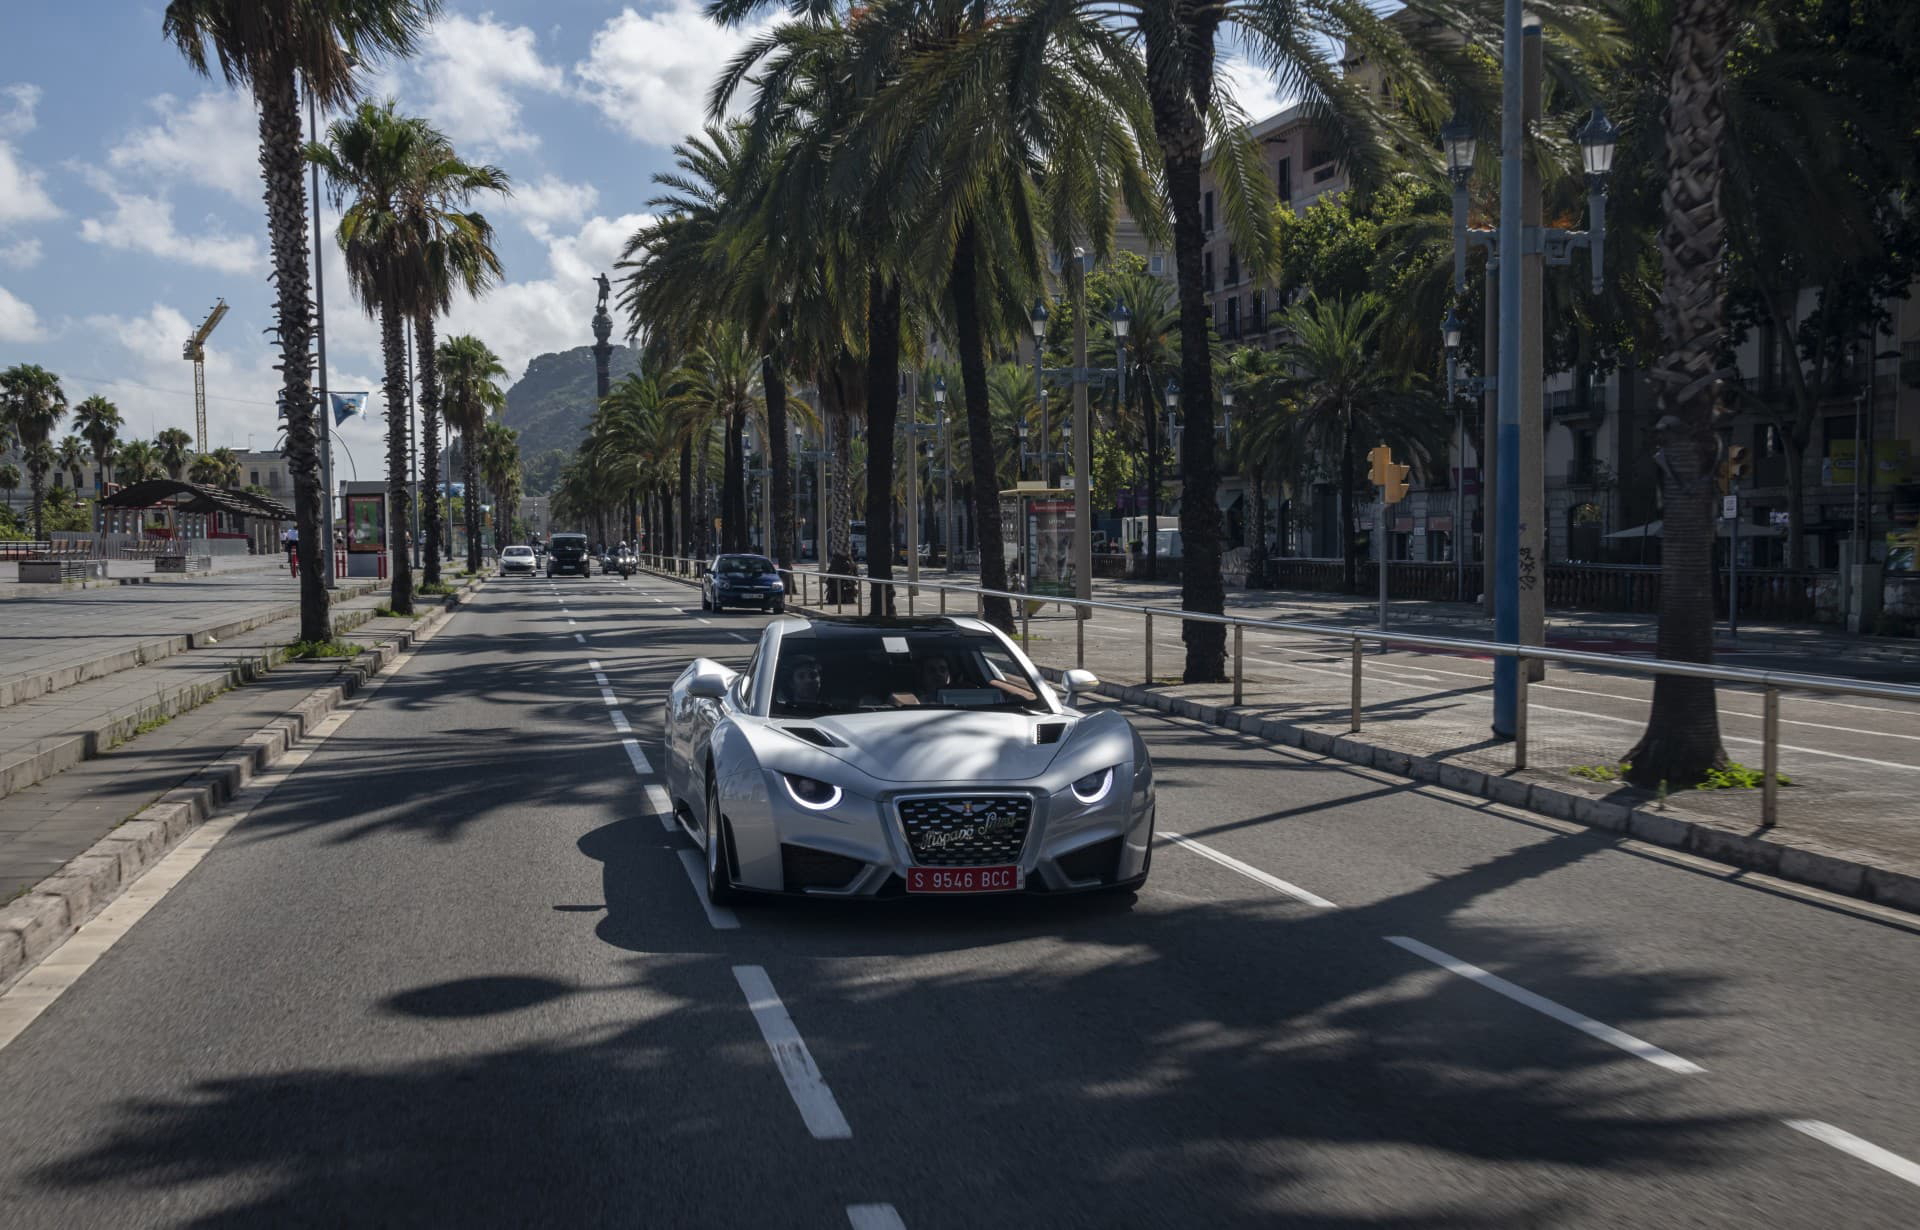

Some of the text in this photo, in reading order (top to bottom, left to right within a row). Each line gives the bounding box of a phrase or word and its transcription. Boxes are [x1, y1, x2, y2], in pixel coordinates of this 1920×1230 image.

[915, 872, 924, 888] S
[933, 872, 973, 888] 9546
[981, 870, 1010, 887] BCC
